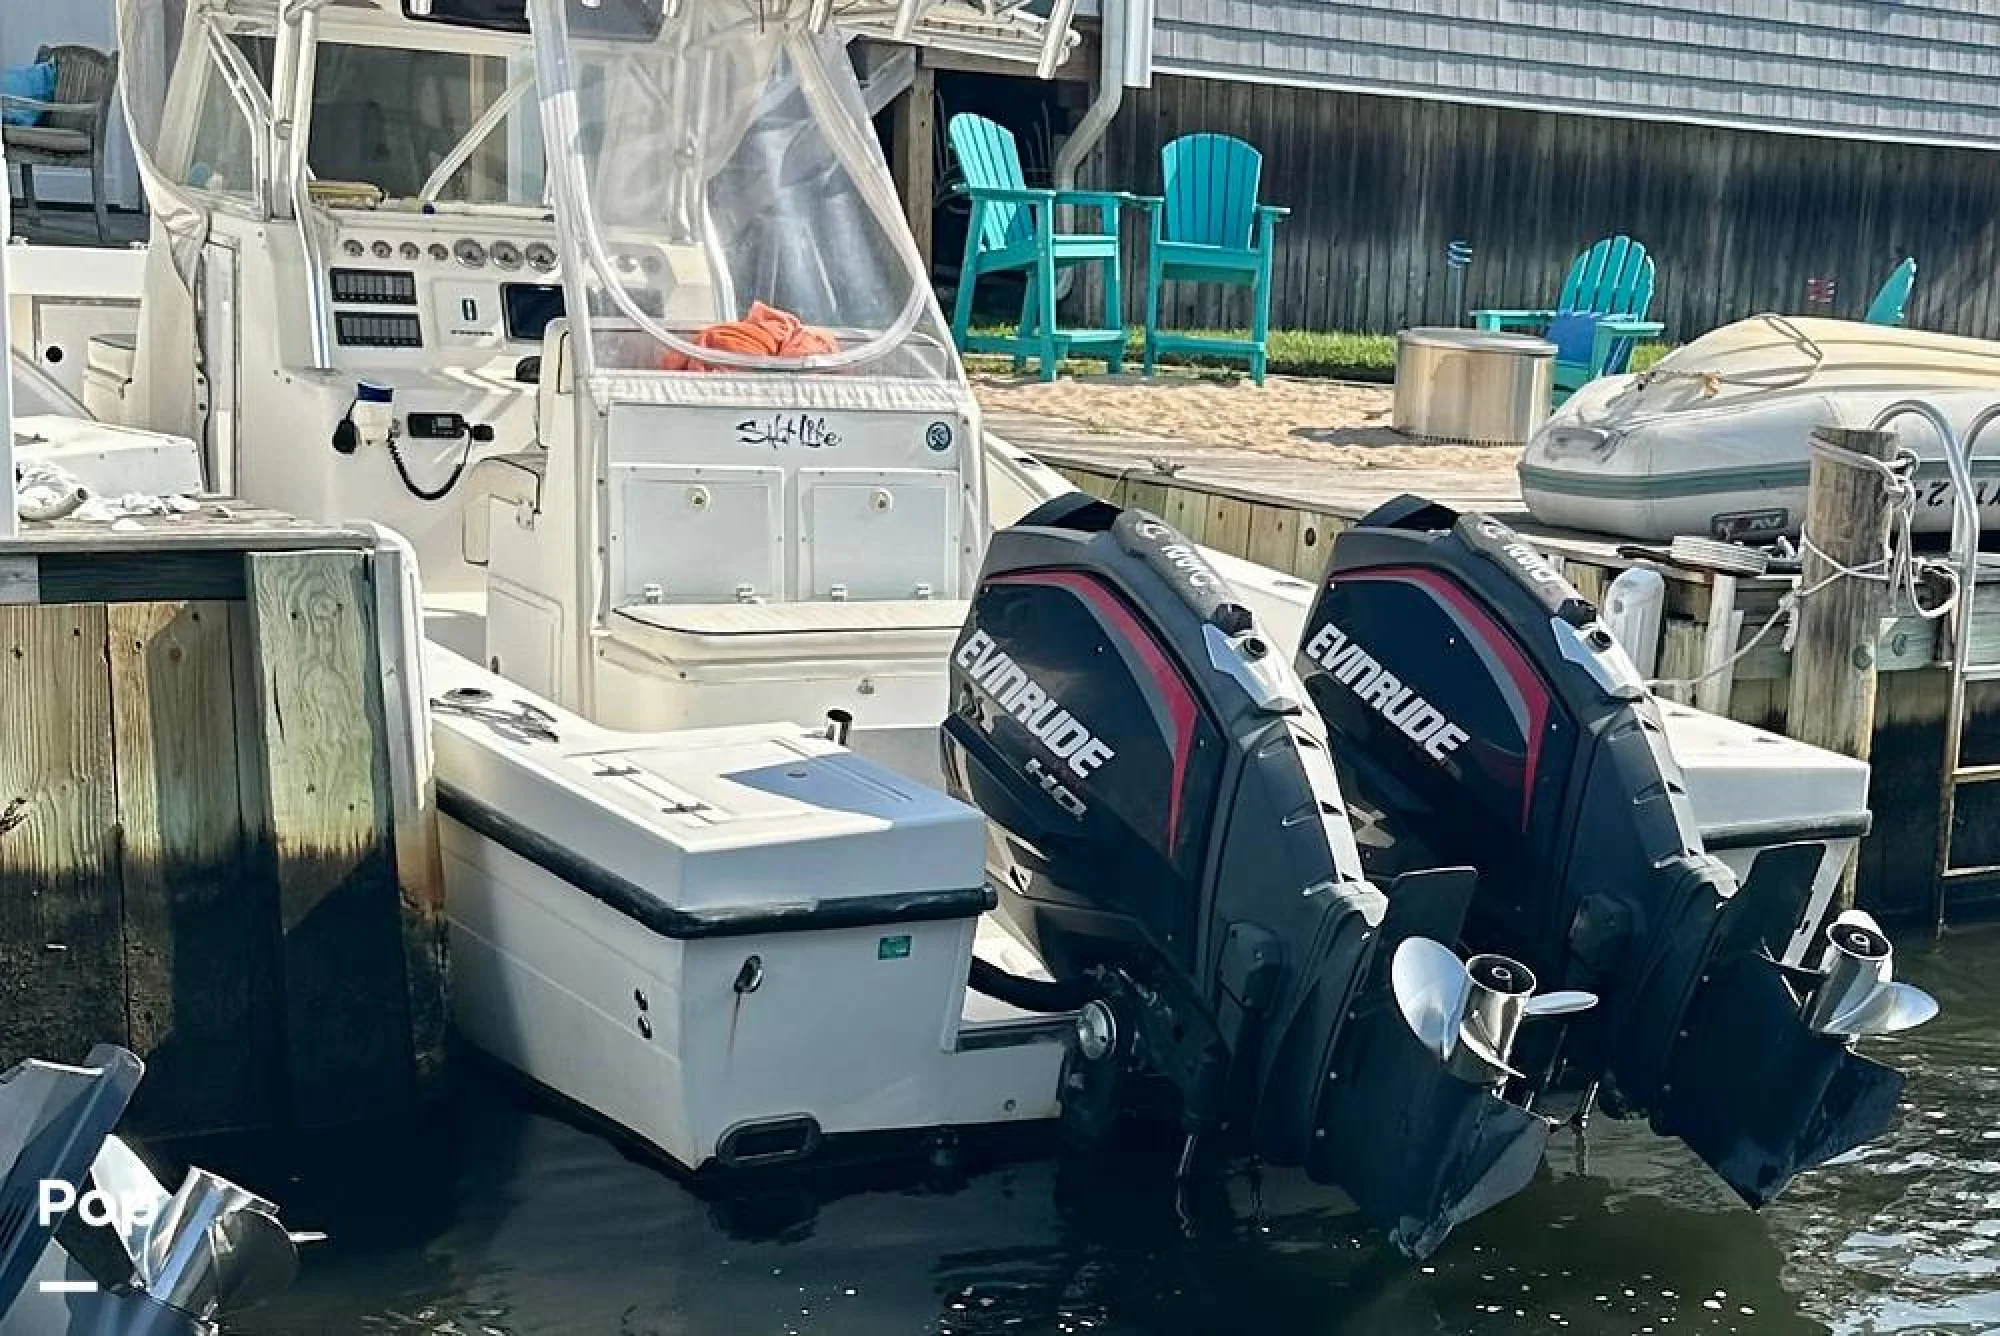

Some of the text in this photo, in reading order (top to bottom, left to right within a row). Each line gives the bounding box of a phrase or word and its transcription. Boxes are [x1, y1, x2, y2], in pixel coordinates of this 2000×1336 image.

[799, 413, 842, 448] Life
[956, 629, 1115, 778] EVINRUDE
[1306, 621, 1471, 760] EVINRUDE
